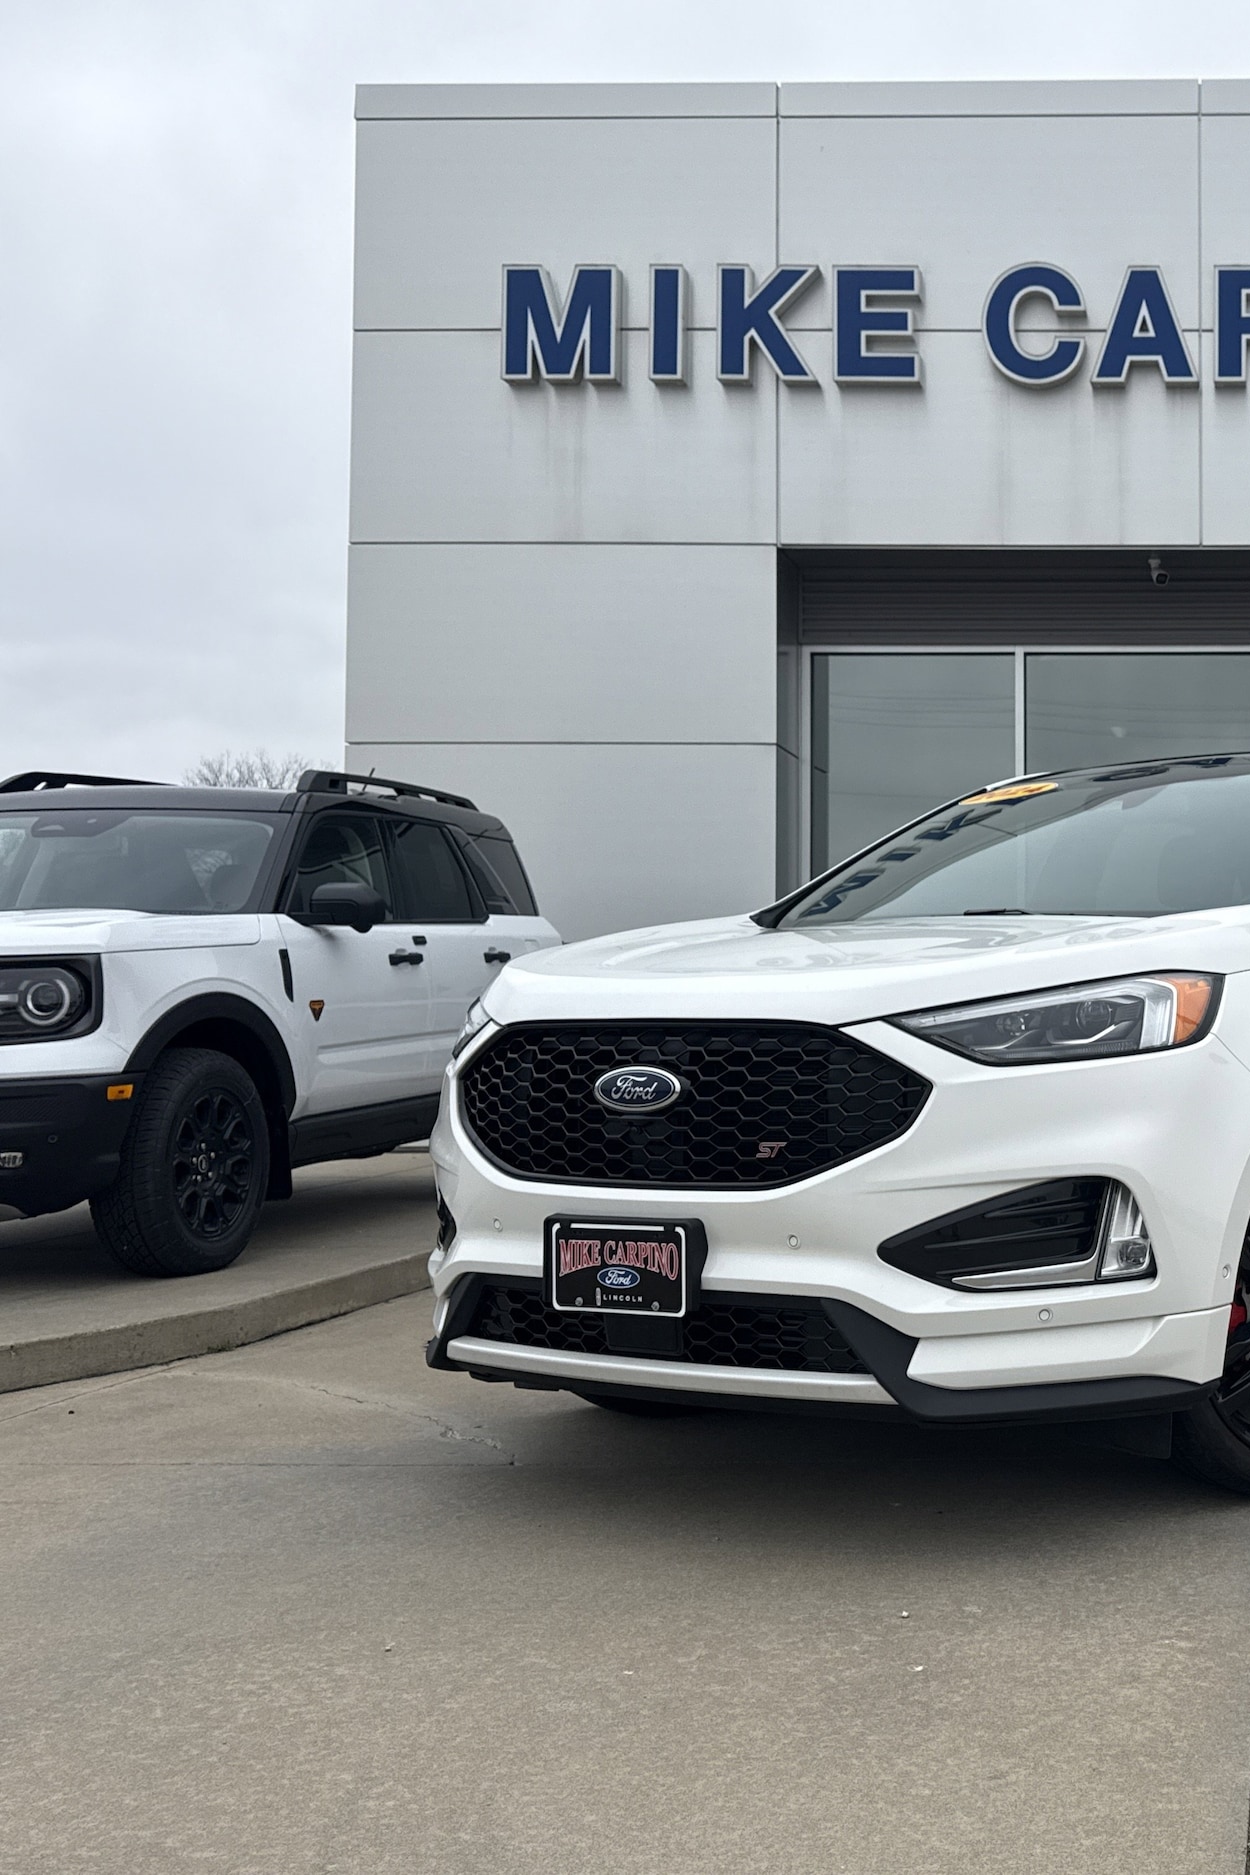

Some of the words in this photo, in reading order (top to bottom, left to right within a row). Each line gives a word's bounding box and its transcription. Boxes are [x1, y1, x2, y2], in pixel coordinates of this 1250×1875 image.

[501, 263, 923, 388] MIKE
[611, 1075, 658, 1100] Ford
[755, 1142, 787, 1158] ST
[559, 1239, 601, 1277] MIKE
[603, 1240, 679, 1281] CARPINO
[605, 1270, 633, 1285] Ford
[602, 1294, 643, 1303] LINCOLN
